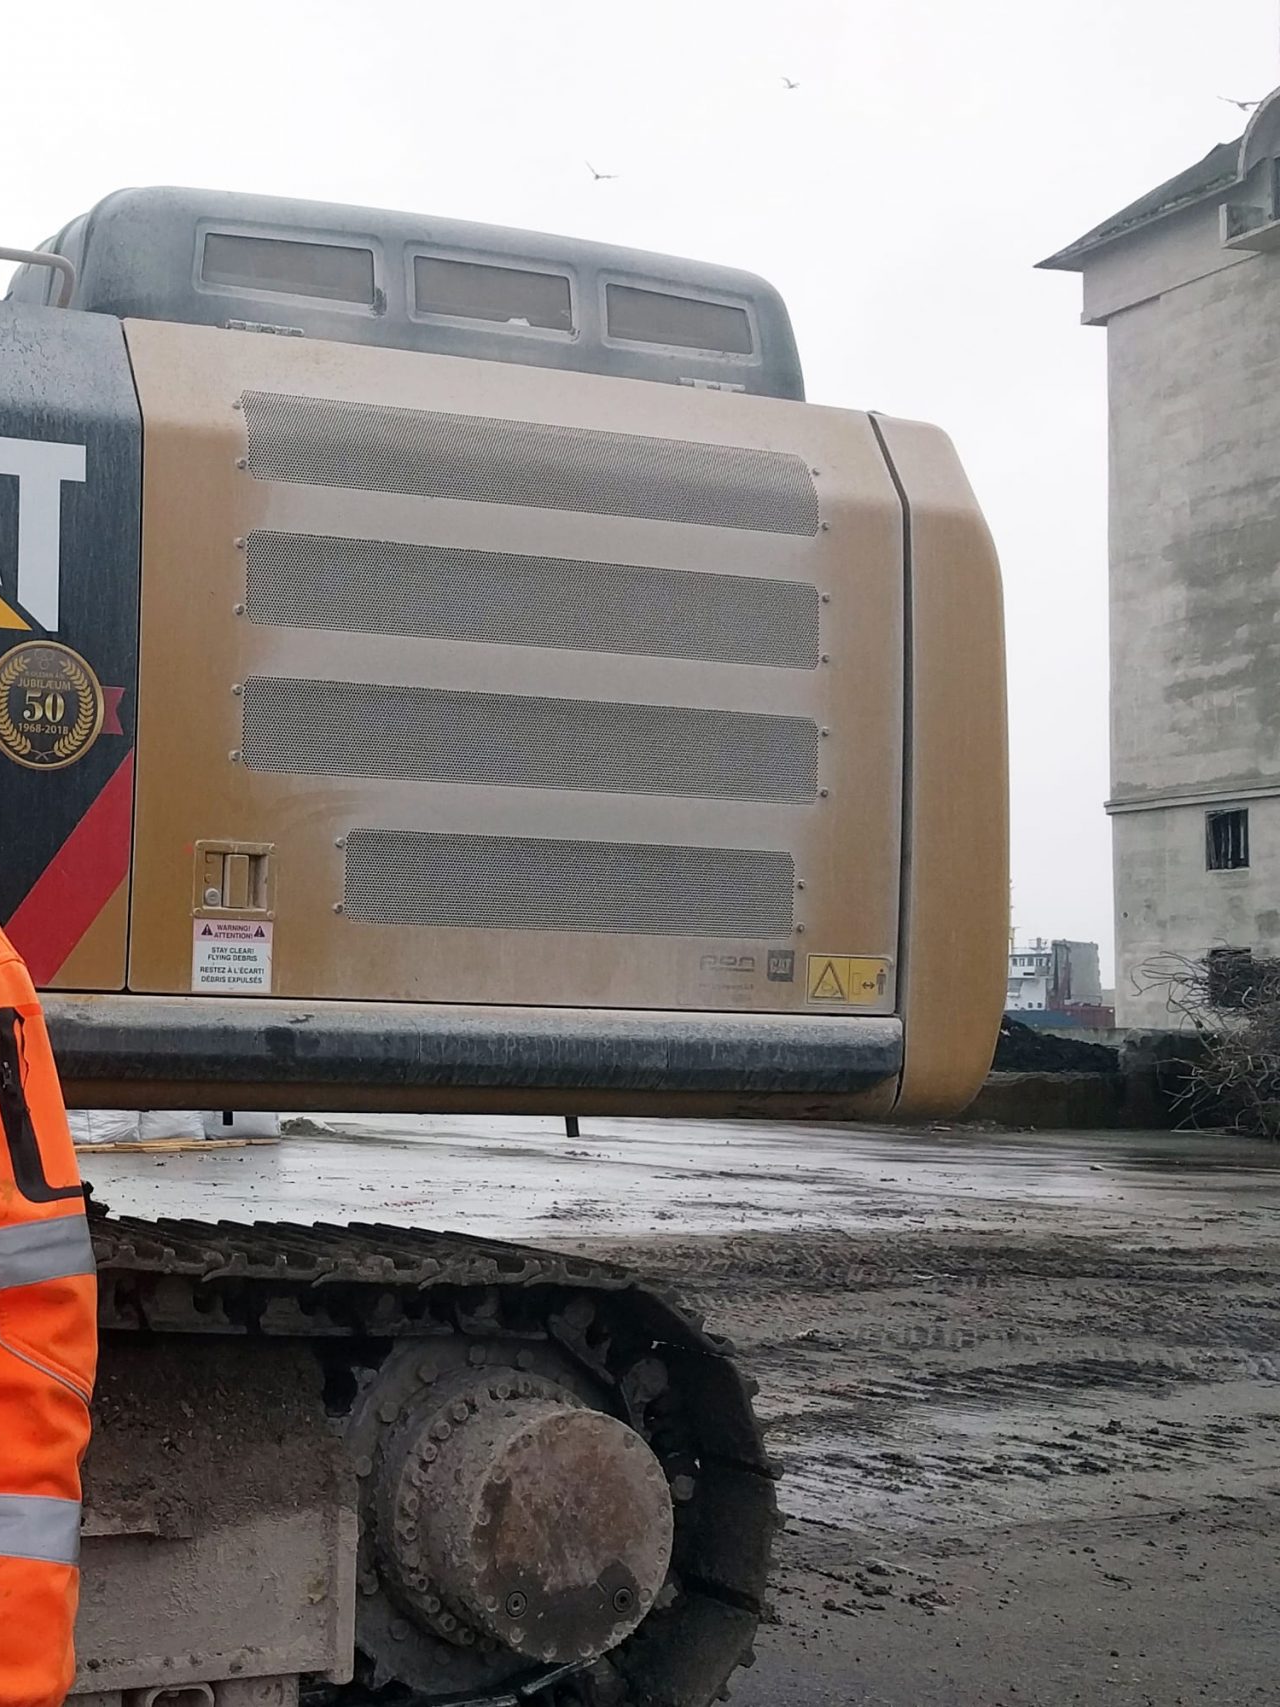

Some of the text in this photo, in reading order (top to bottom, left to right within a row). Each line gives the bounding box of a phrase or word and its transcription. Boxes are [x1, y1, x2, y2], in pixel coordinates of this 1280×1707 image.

[17, 677, 71, 690] JUBILÆUM
[23, 689, 65, 723] 50
[18, 722, 69, 735] 1968-2018
[216, 924, 251, 932] WARNING!
[213, 931, 254, 939] ATTENTION!
[211, 946, 228, 954] STAY
[207, 953, 231, 961] FLYING
[200, 966, 226, 974] RESTEZ
